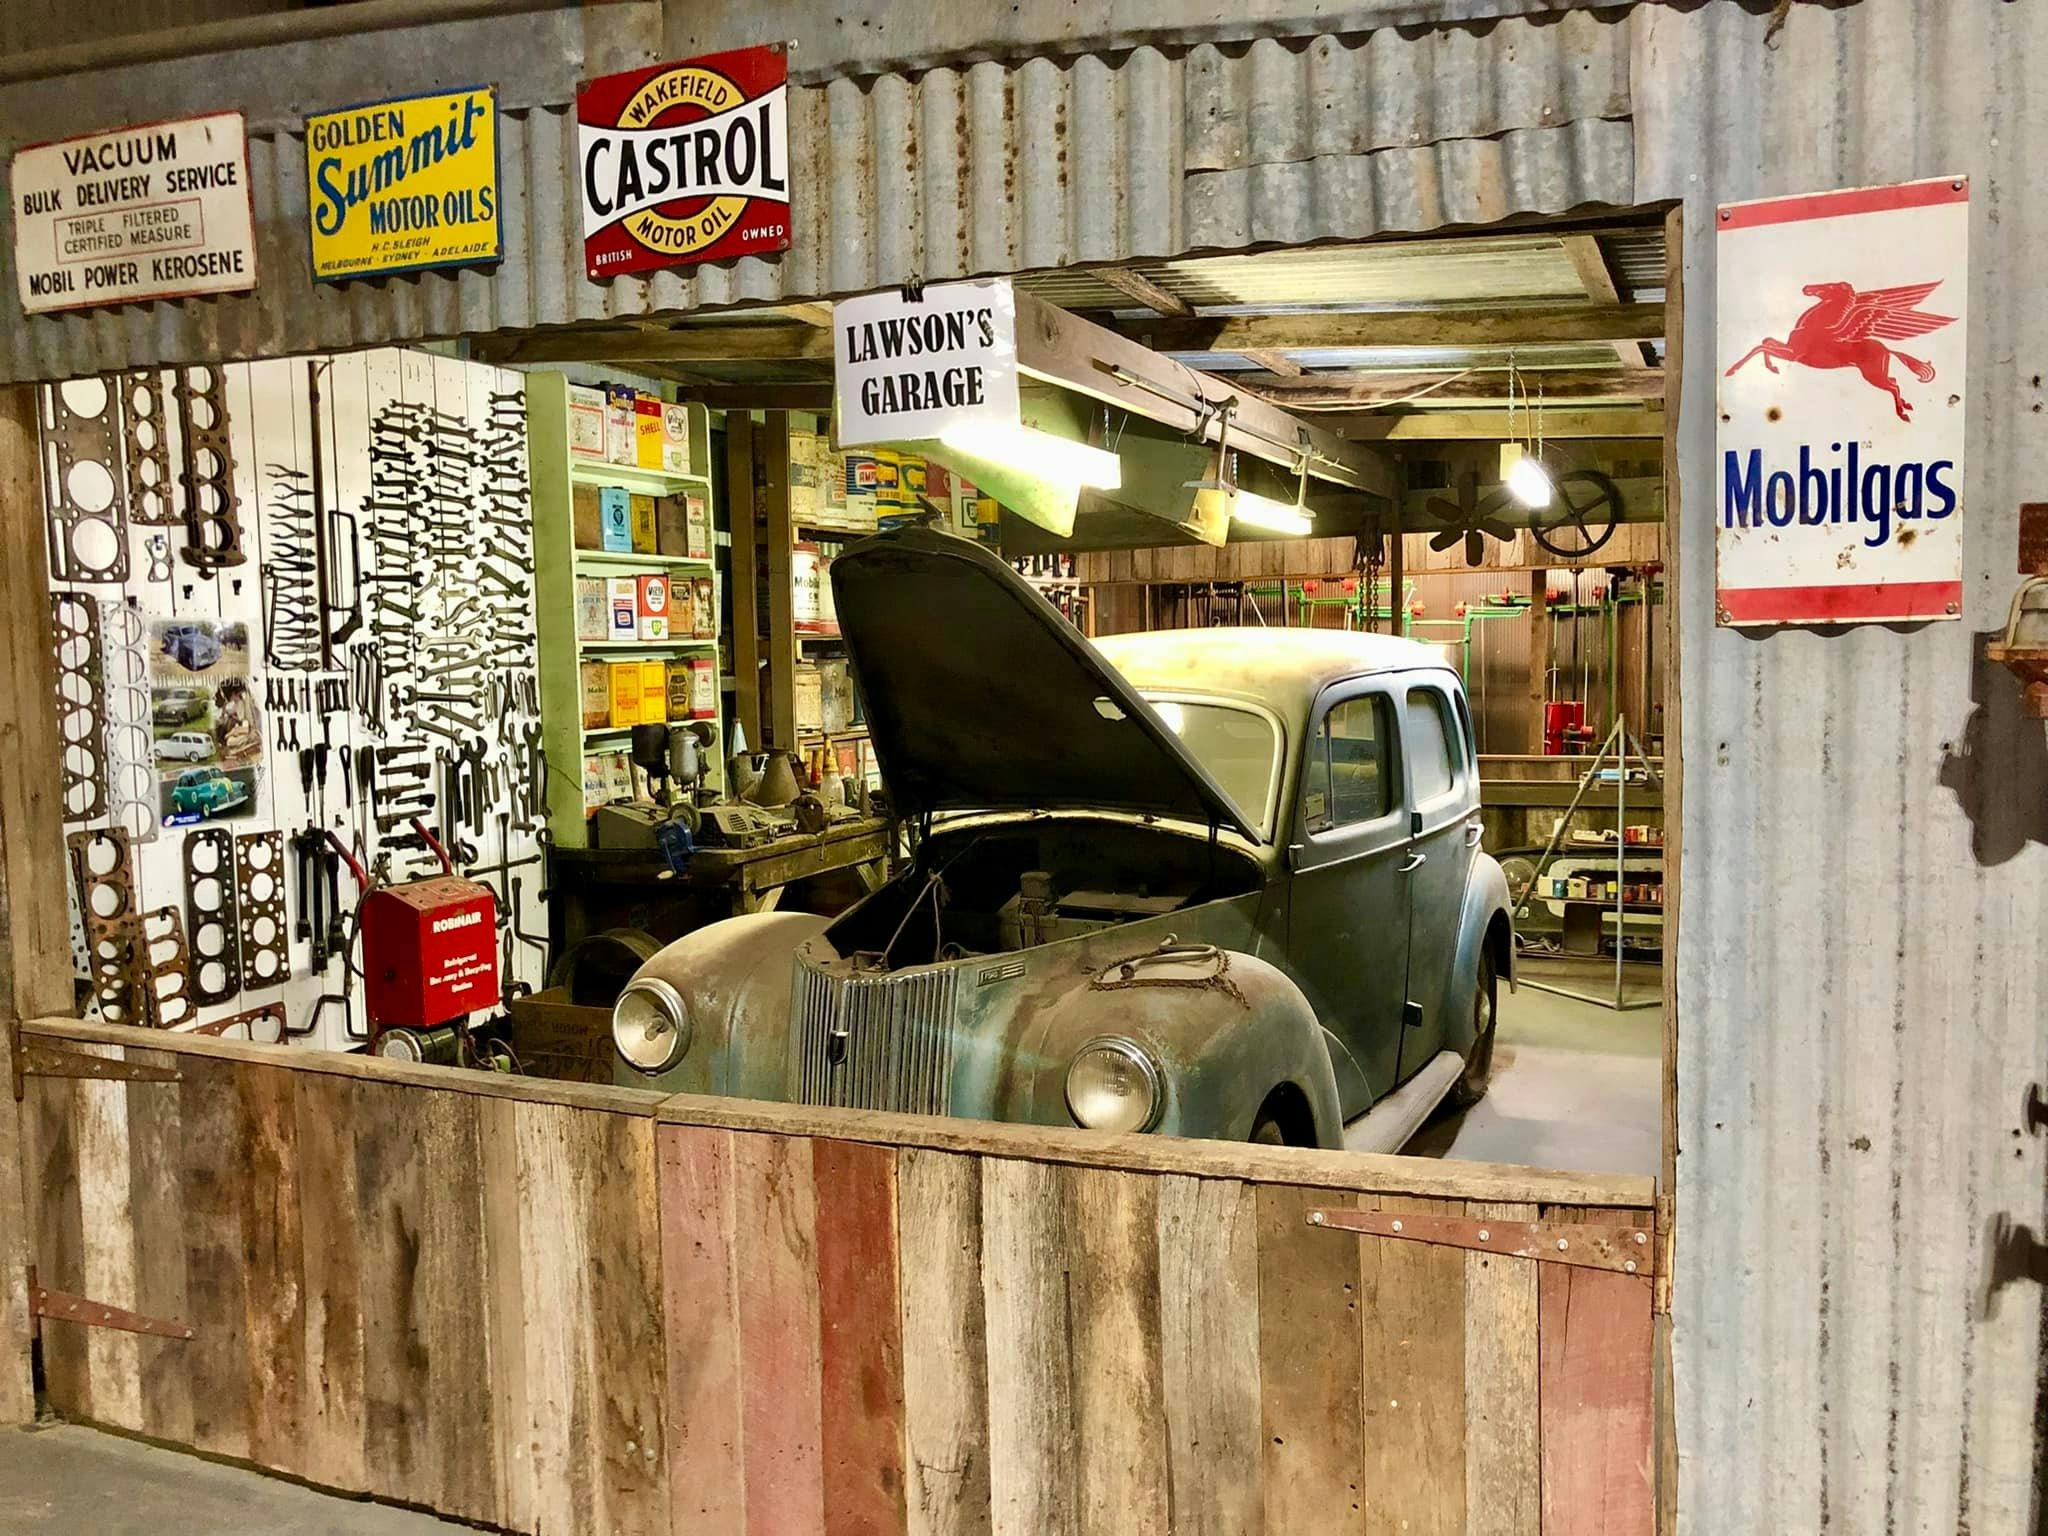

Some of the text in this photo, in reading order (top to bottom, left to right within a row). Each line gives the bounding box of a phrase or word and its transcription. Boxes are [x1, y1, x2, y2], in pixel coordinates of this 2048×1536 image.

[629, 75, 727, 124] WAKEFIELD
[313, 110, 404, 151] GOLDEN
[63, 133, 176, 175] VACUUM
[316, 95, 485, 236] Summit
[585, 103, 784, 216] CASTROL
[24, 162, 236, 215] BULK DELIVERY SERVICE
[68, 208, 179, 236] TRIPLE FILTERED
[370, 186, 494, 235] MOTOR OILS
[637, 206, 732, 248] MOTOR OIL
[64, 224, 192, 254] CERTIFIED MEASURE
[393, 236, 430, 250] SLEIGH
[742, 224, 783, 241] OWNED
[30, 250, 243, 296] MOBIL POWER KEROSENE
[321, 256, 373, 270] MELBOURNE
[432, 242, 489, 257] ADELAIDE
[596, 250, 632, 265] BRITISH
[847, 308, 994, 363] LAWSON'S
[861, 366, 984, 416] GARAGE
[640, 422, 661, 436] SHELL
[859, 469, 876, 482] AMP
[1725, 441, 1956, 547] Mobilgas
[433, 912, 482, 933] ROBINAIR
